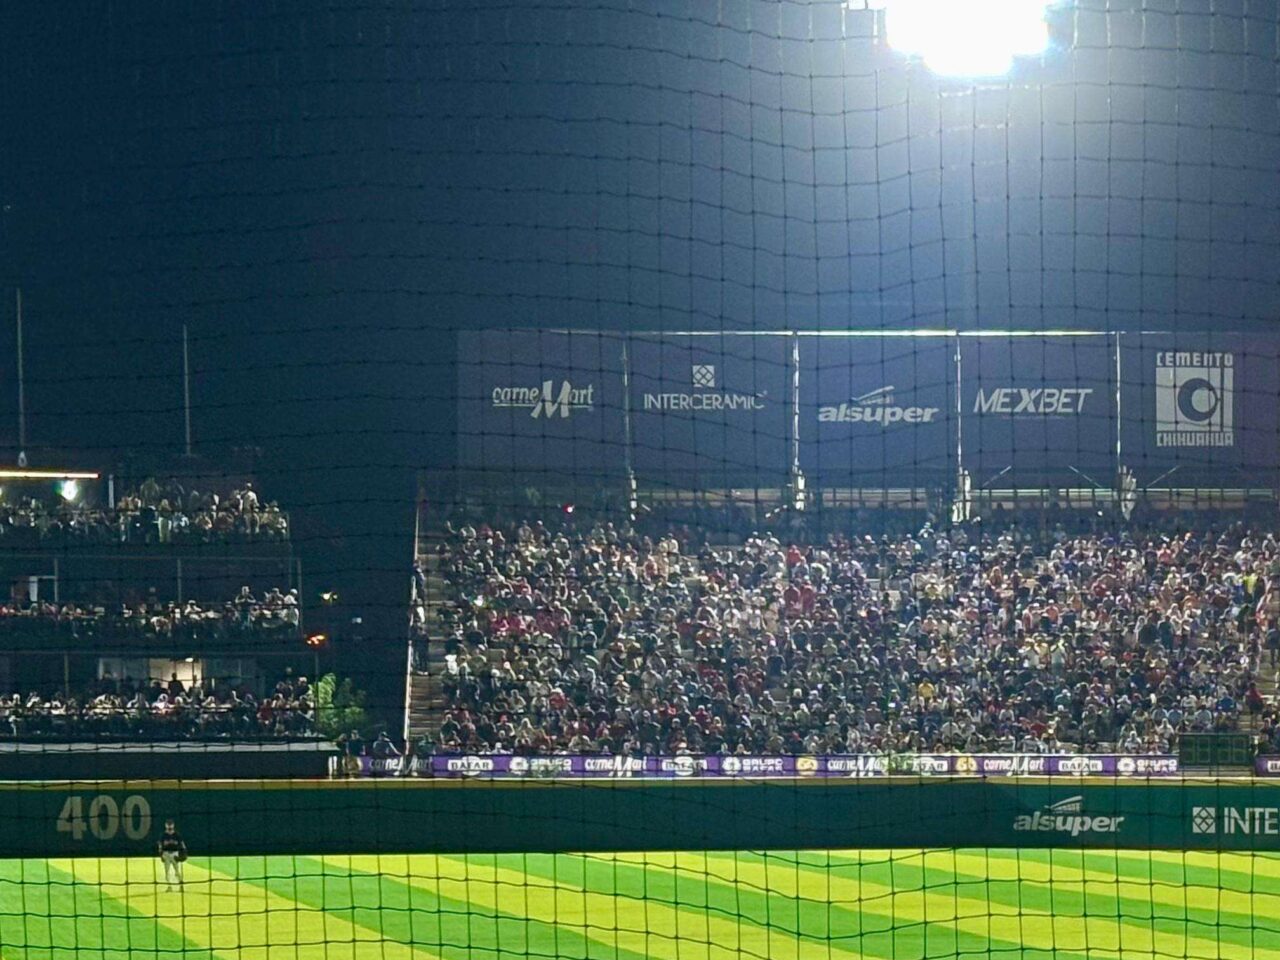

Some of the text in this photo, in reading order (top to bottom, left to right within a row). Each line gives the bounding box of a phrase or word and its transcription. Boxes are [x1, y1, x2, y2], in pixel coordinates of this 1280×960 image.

[1156, 352, 1233, 367] CEMENTO
[643, 393, 766, 410] INTERCERAMIC
[974, 388, 1093, 413] MEXBET
[818, 404, 938, 427] alsuper
[1156, 432, 1233, 447] CHIHUAHUA
[56, 795, 152, 840] 400
[1013, 814, 1125, 837] alsuper
